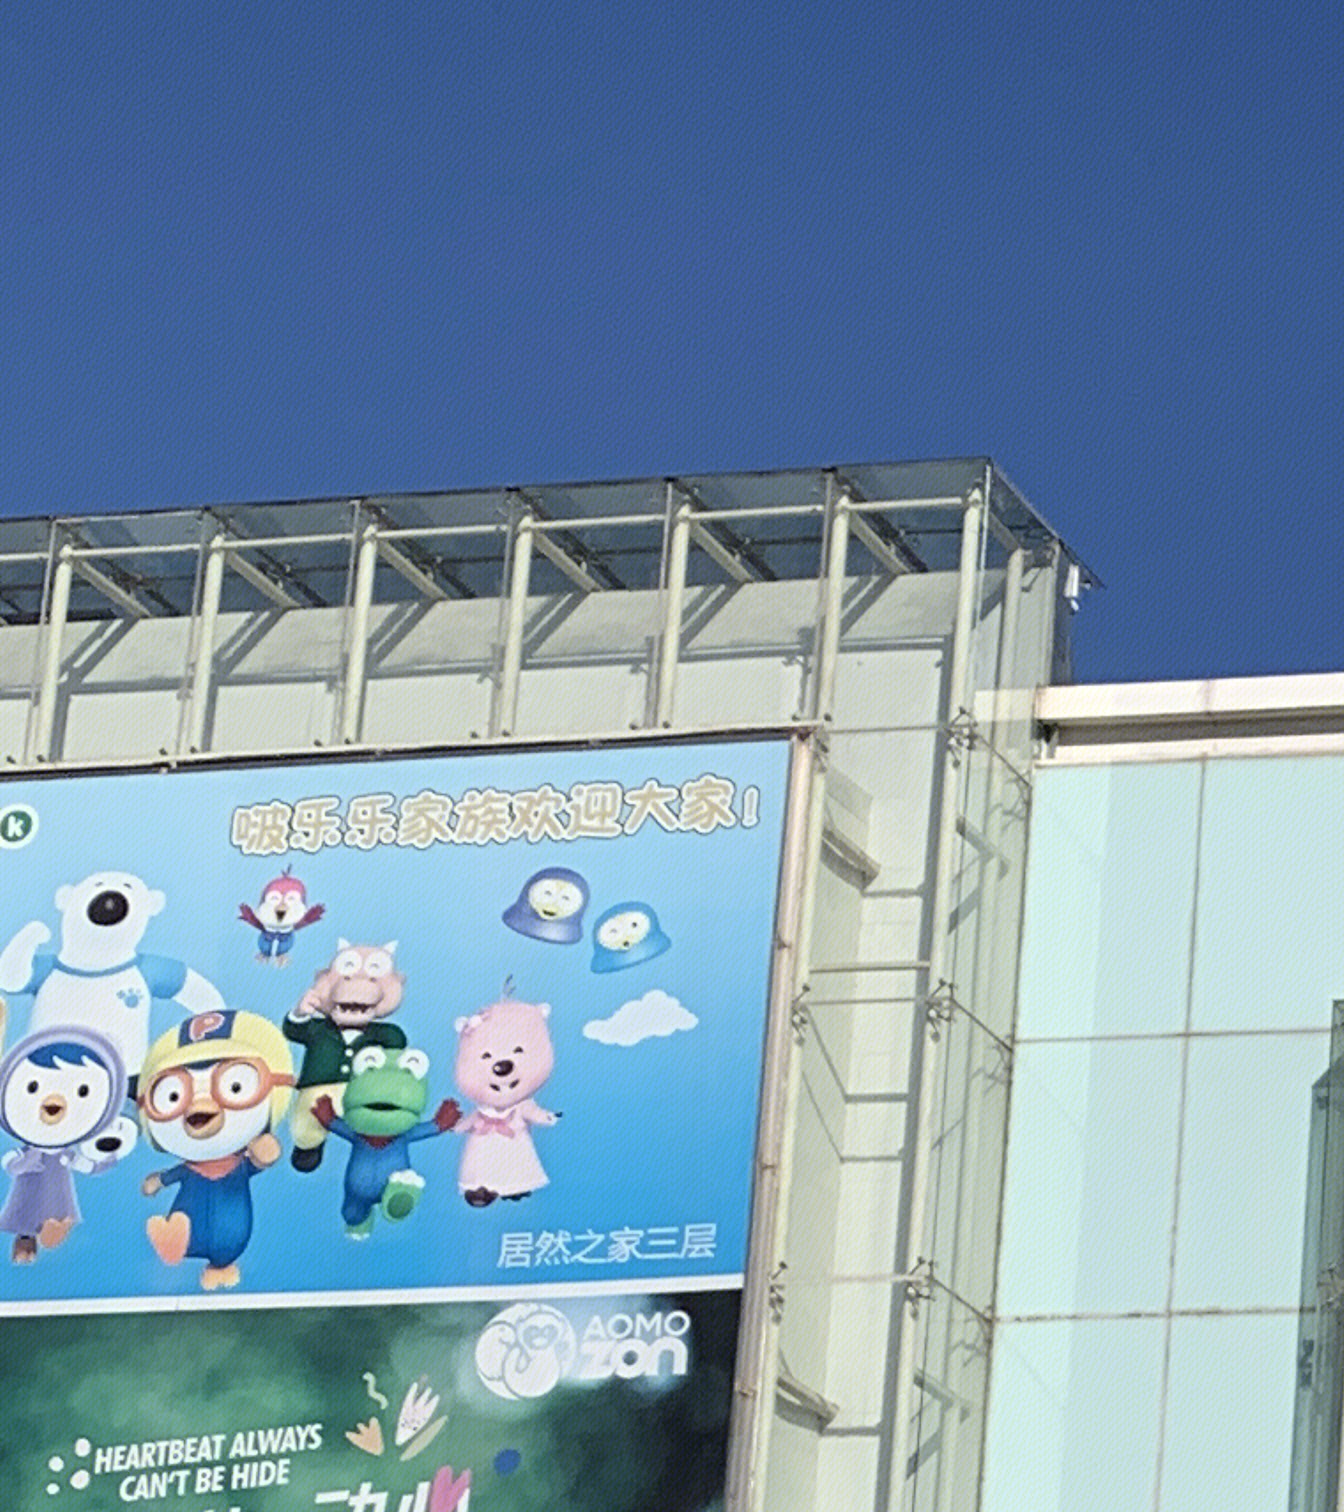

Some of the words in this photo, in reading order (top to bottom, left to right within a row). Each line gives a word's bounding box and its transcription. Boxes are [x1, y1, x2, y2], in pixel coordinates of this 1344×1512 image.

[497, 1223, 717, 1269] 居然之家三层
[583, 1310, 691, 1340] AOMO
[95, 1432, 227, 1474] HEARTBEAT
[230, 1424, 323, 1459] ALWAYS
[119, 1468, 190, 1501] CAN'T
[195, 1465, 227, 1494] BE
[231, 1458, 291, 1490] HIDE
